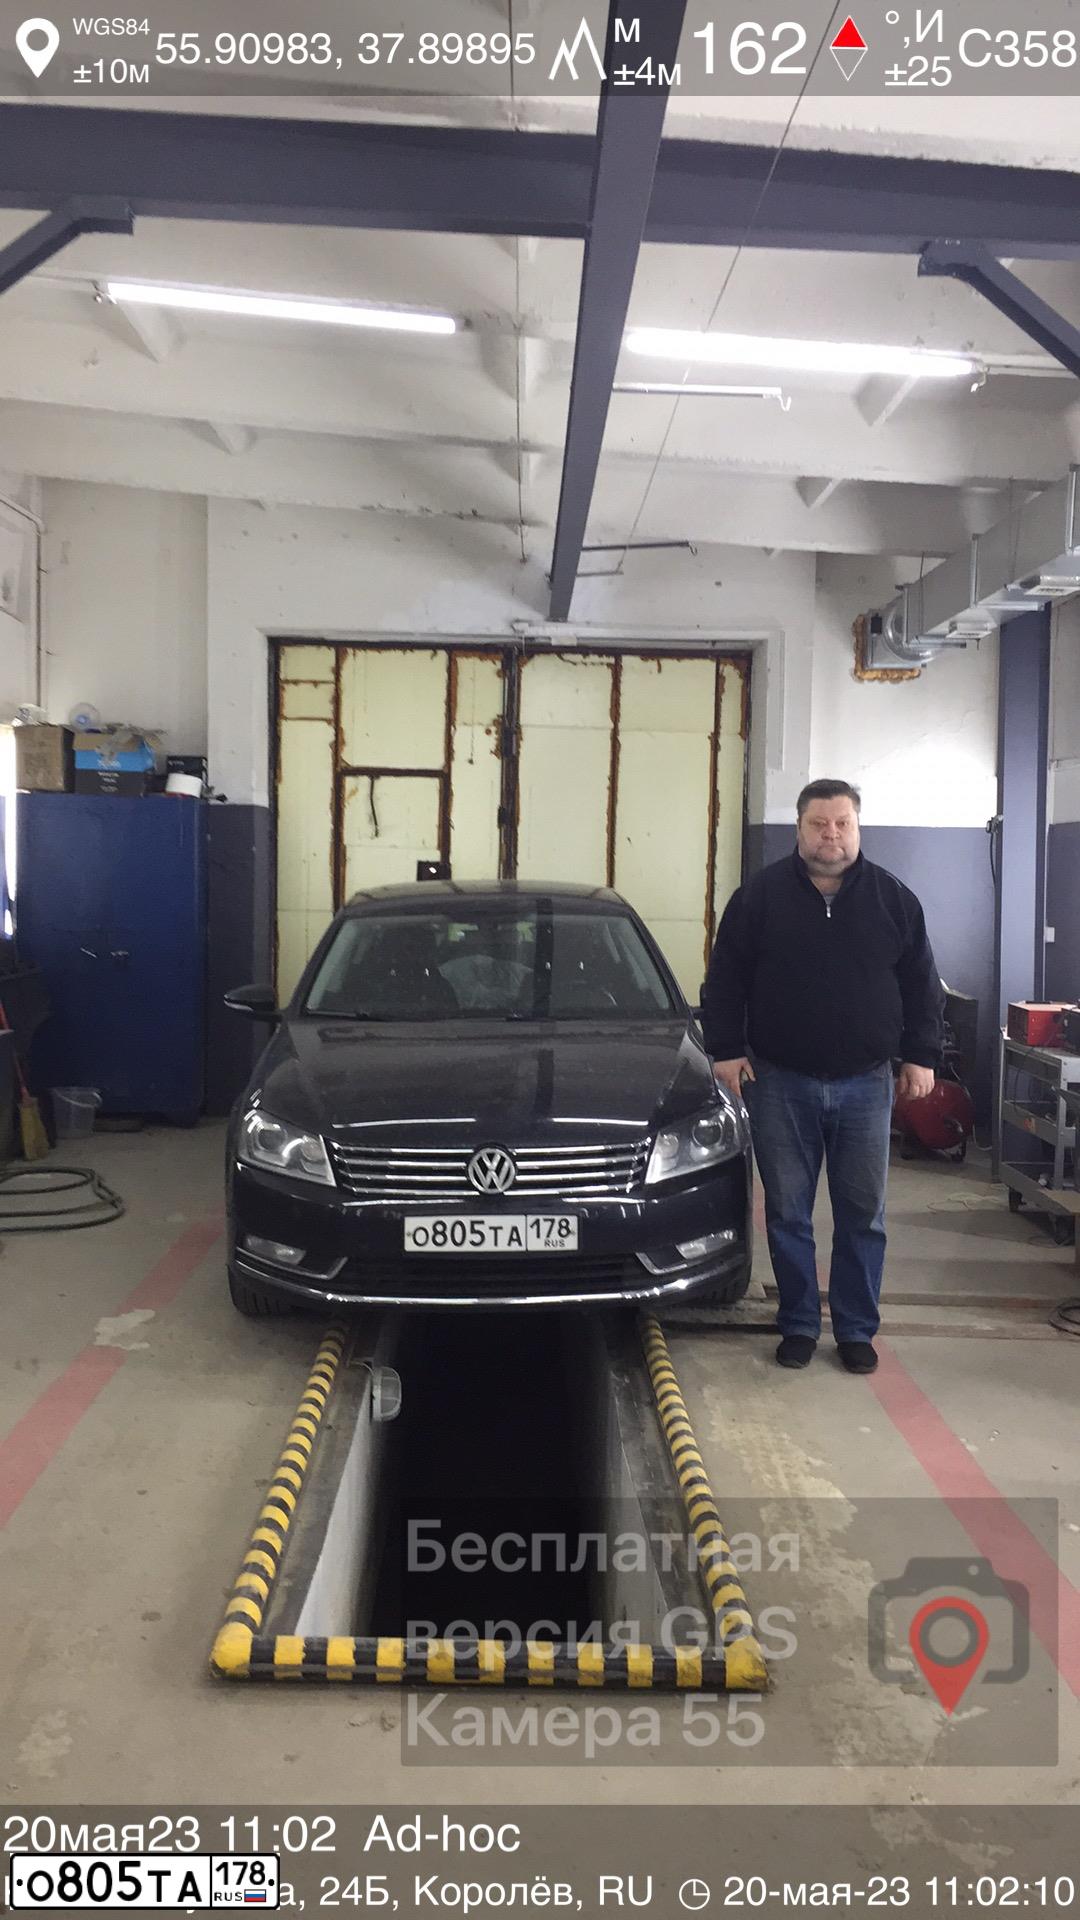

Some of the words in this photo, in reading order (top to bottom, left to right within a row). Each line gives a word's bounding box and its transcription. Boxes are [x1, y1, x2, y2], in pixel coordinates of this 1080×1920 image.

[469, 1148, 515, 1194] VW
[412, 1219, 523, 1247] О805ТА
[529, 1217, 572, 1239] 178
[543, 1238, 566, 1248] RUS
